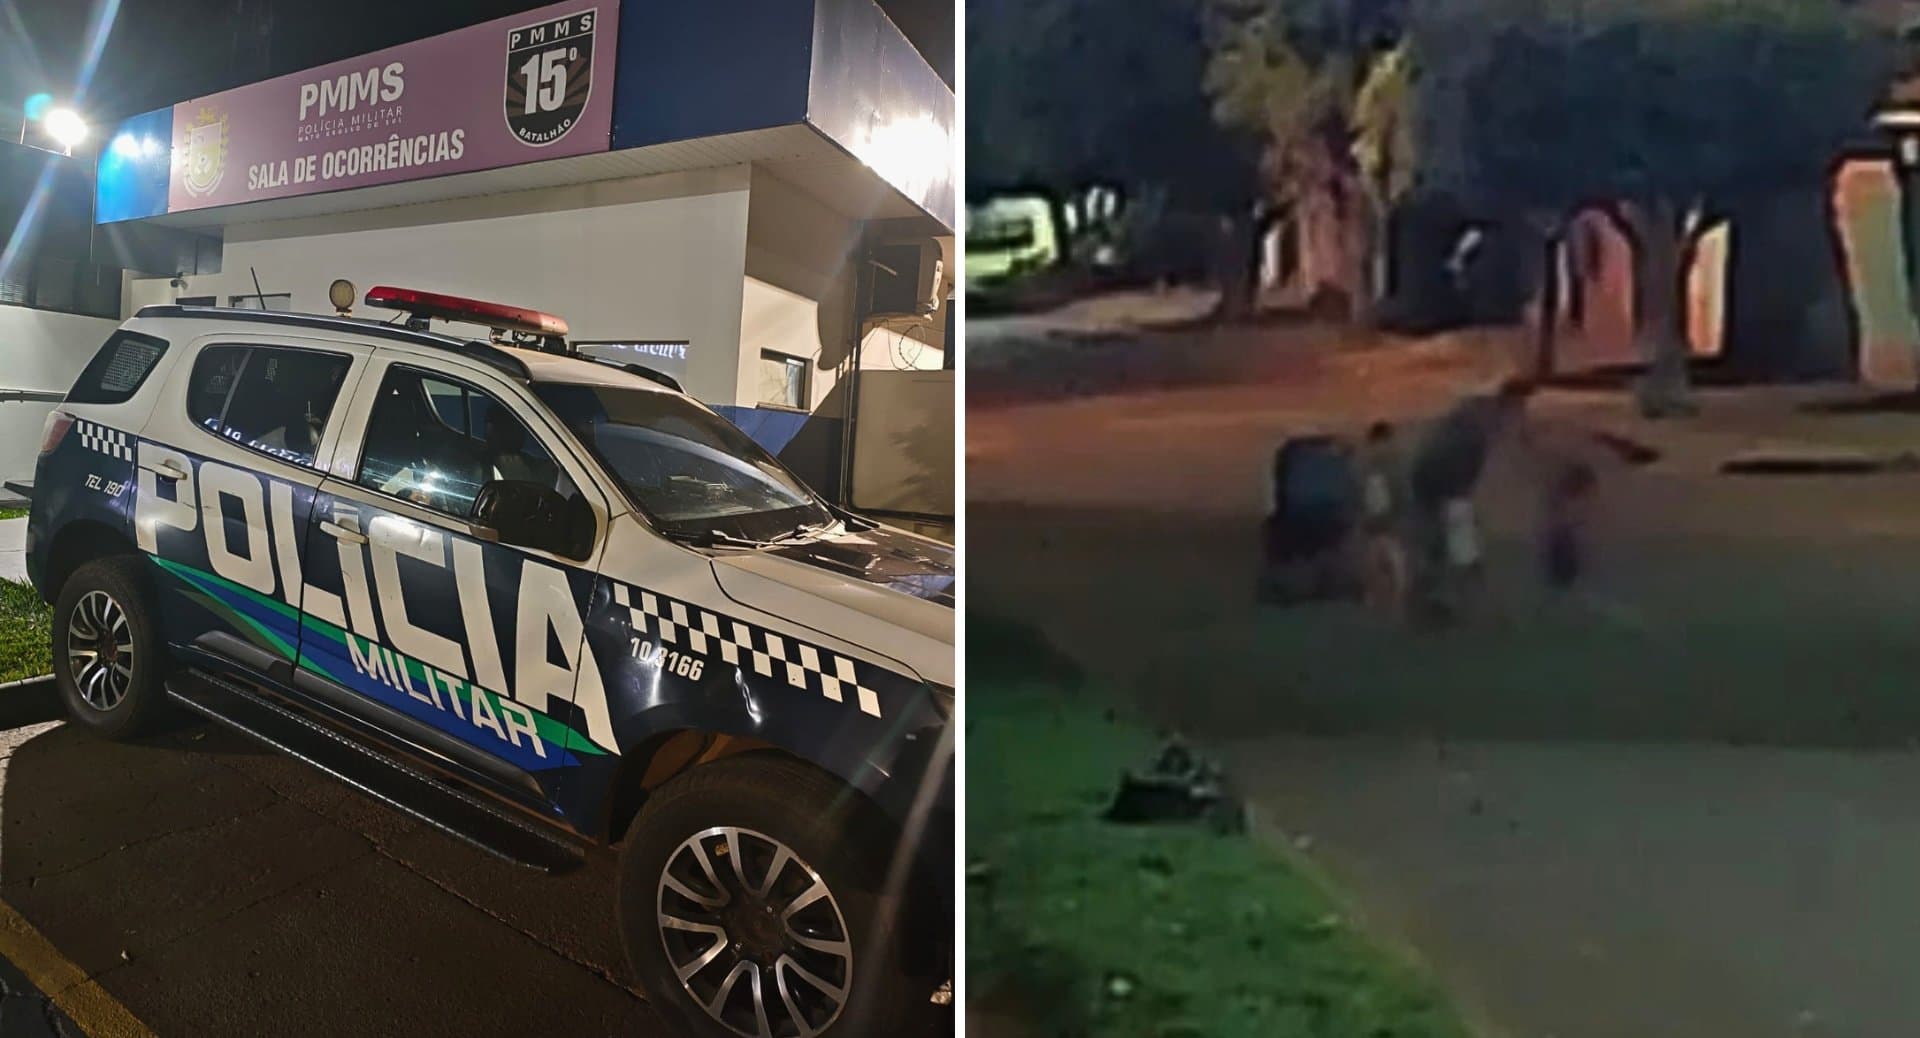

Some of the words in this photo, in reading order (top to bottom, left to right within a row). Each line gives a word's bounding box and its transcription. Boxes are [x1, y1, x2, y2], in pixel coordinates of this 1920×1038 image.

[298, 118, 344, 136] POLÍCIA
[351, 105, 402, 125] MILITAR
[299, 62, 405, 121] PMMS
[248, 160, 289, 190] SALA
[293, 155, 317, 184] DE
[322, 129, 465, 180] OCORRÊNCIAS
[85, 473, 102, 490] TEL
[104, 480, 125, 497] 190
[344, 631, 547, 759] MILITAR
